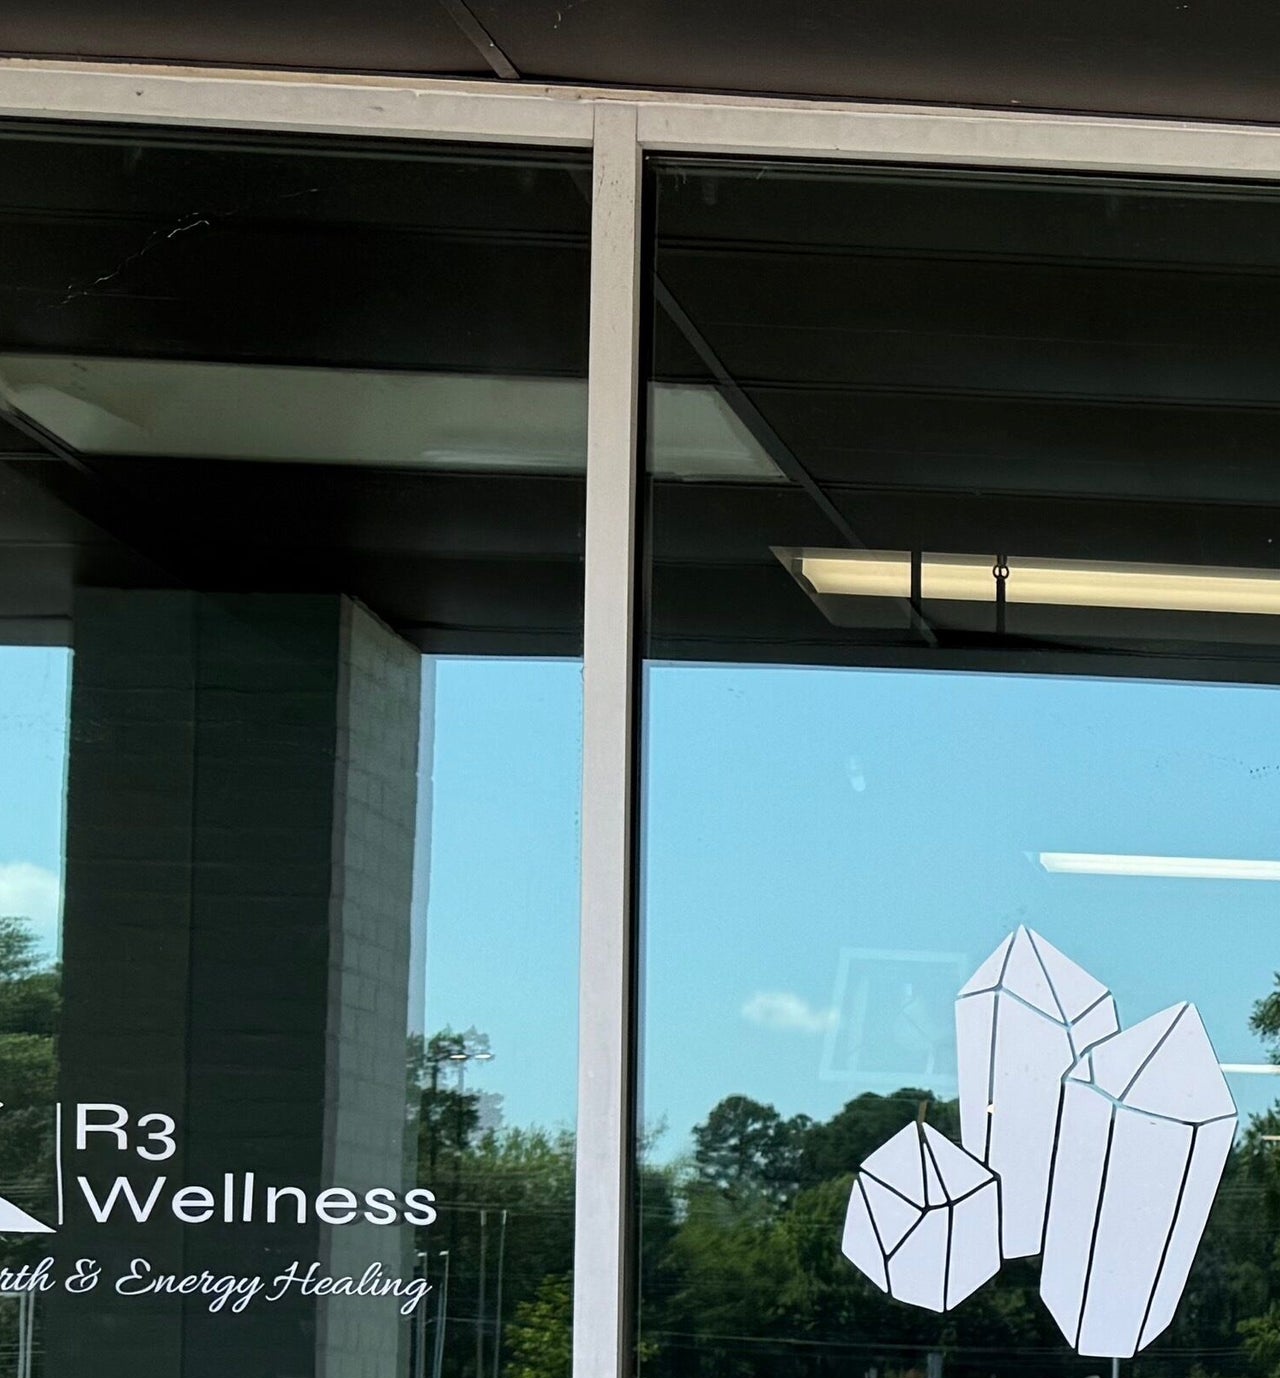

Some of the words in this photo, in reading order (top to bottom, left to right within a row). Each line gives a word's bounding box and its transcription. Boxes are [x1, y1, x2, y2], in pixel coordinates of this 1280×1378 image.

[76, 1103, 176, 1161] R3
[77, 1172, 437, 1226] Wellness
[65, 1258, 102, 1294] &
[115, 1258, 265, 1313] Energy
[265, 1261, 433, 1315] Healing
